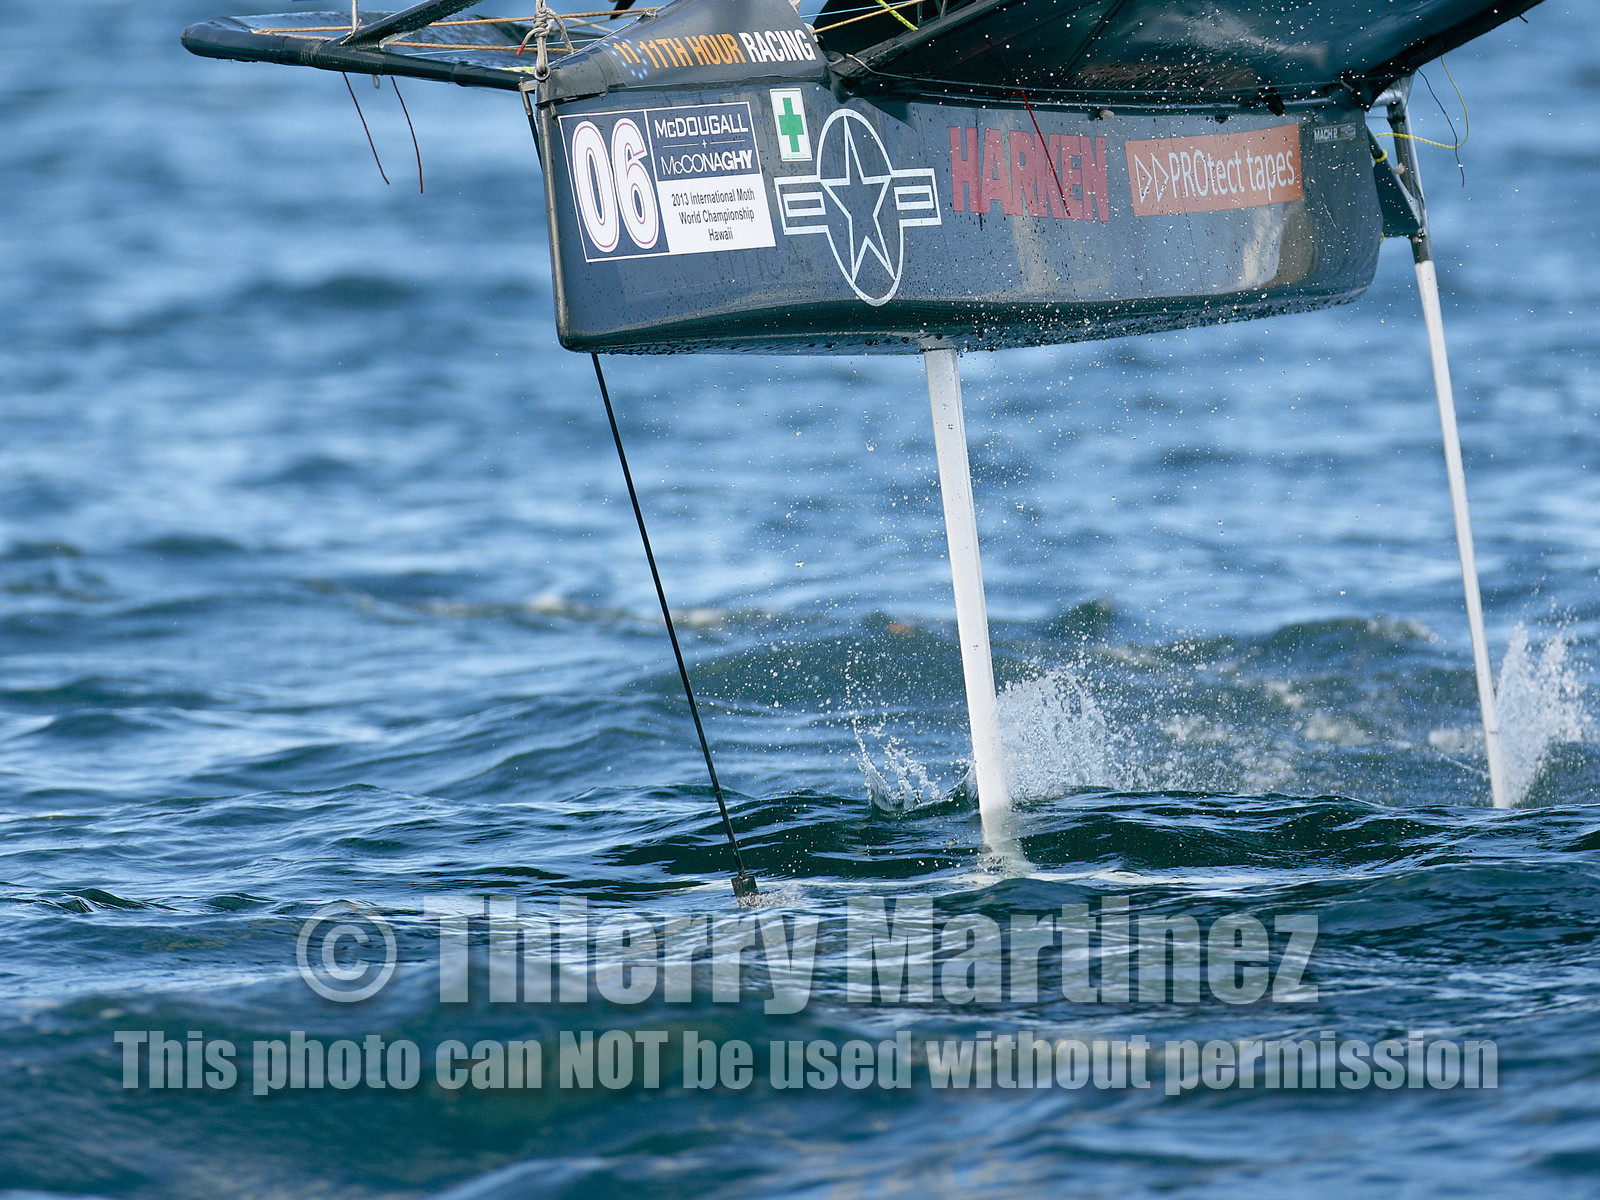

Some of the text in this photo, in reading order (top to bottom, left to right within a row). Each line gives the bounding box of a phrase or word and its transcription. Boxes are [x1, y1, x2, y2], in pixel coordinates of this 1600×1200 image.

[639, 37, 694, 69] 11TH
[684, 33, 747, 66] HOUR
[738, 29, 817, 63] RACING
[1314, 127, 1333, 142] MACH
[572, 117, 660, 253] 06
[949, 125, 1111, 223] HARKEN
[1168, 149, 1295, 199] PROtect tapes
[671, 187, 756, 207] 2013 International Moth
[679, 206, 756, 225] World Championship
[707, 226, 734, 242] Hawaii
